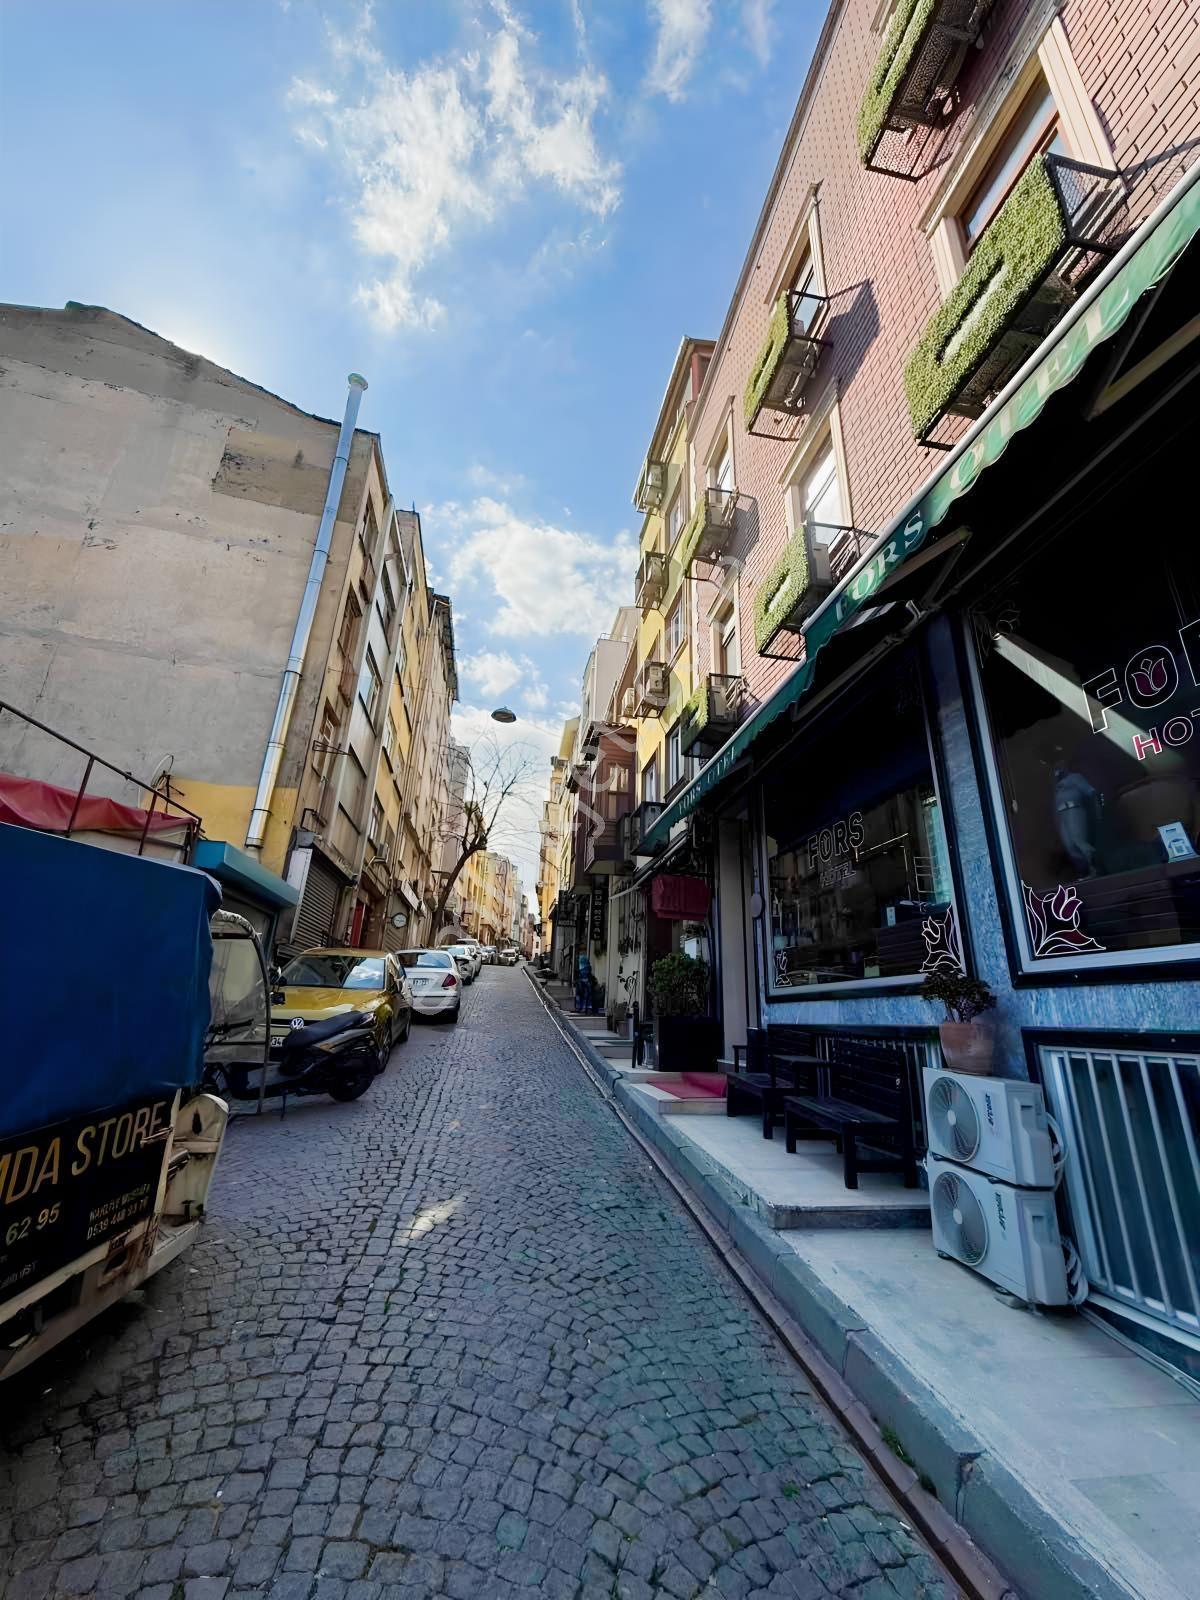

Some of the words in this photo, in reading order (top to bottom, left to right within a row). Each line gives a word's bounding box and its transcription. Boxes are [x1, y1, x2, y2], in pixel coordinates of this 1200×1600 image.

[834, 510, 922, 621] FORS
[807, 811, 867, 869] FORS
[71, 1101, 167, 1176] STORE
[5, 1216, 32, 1246] 62
[35, 1202, 62, 1231] 95
